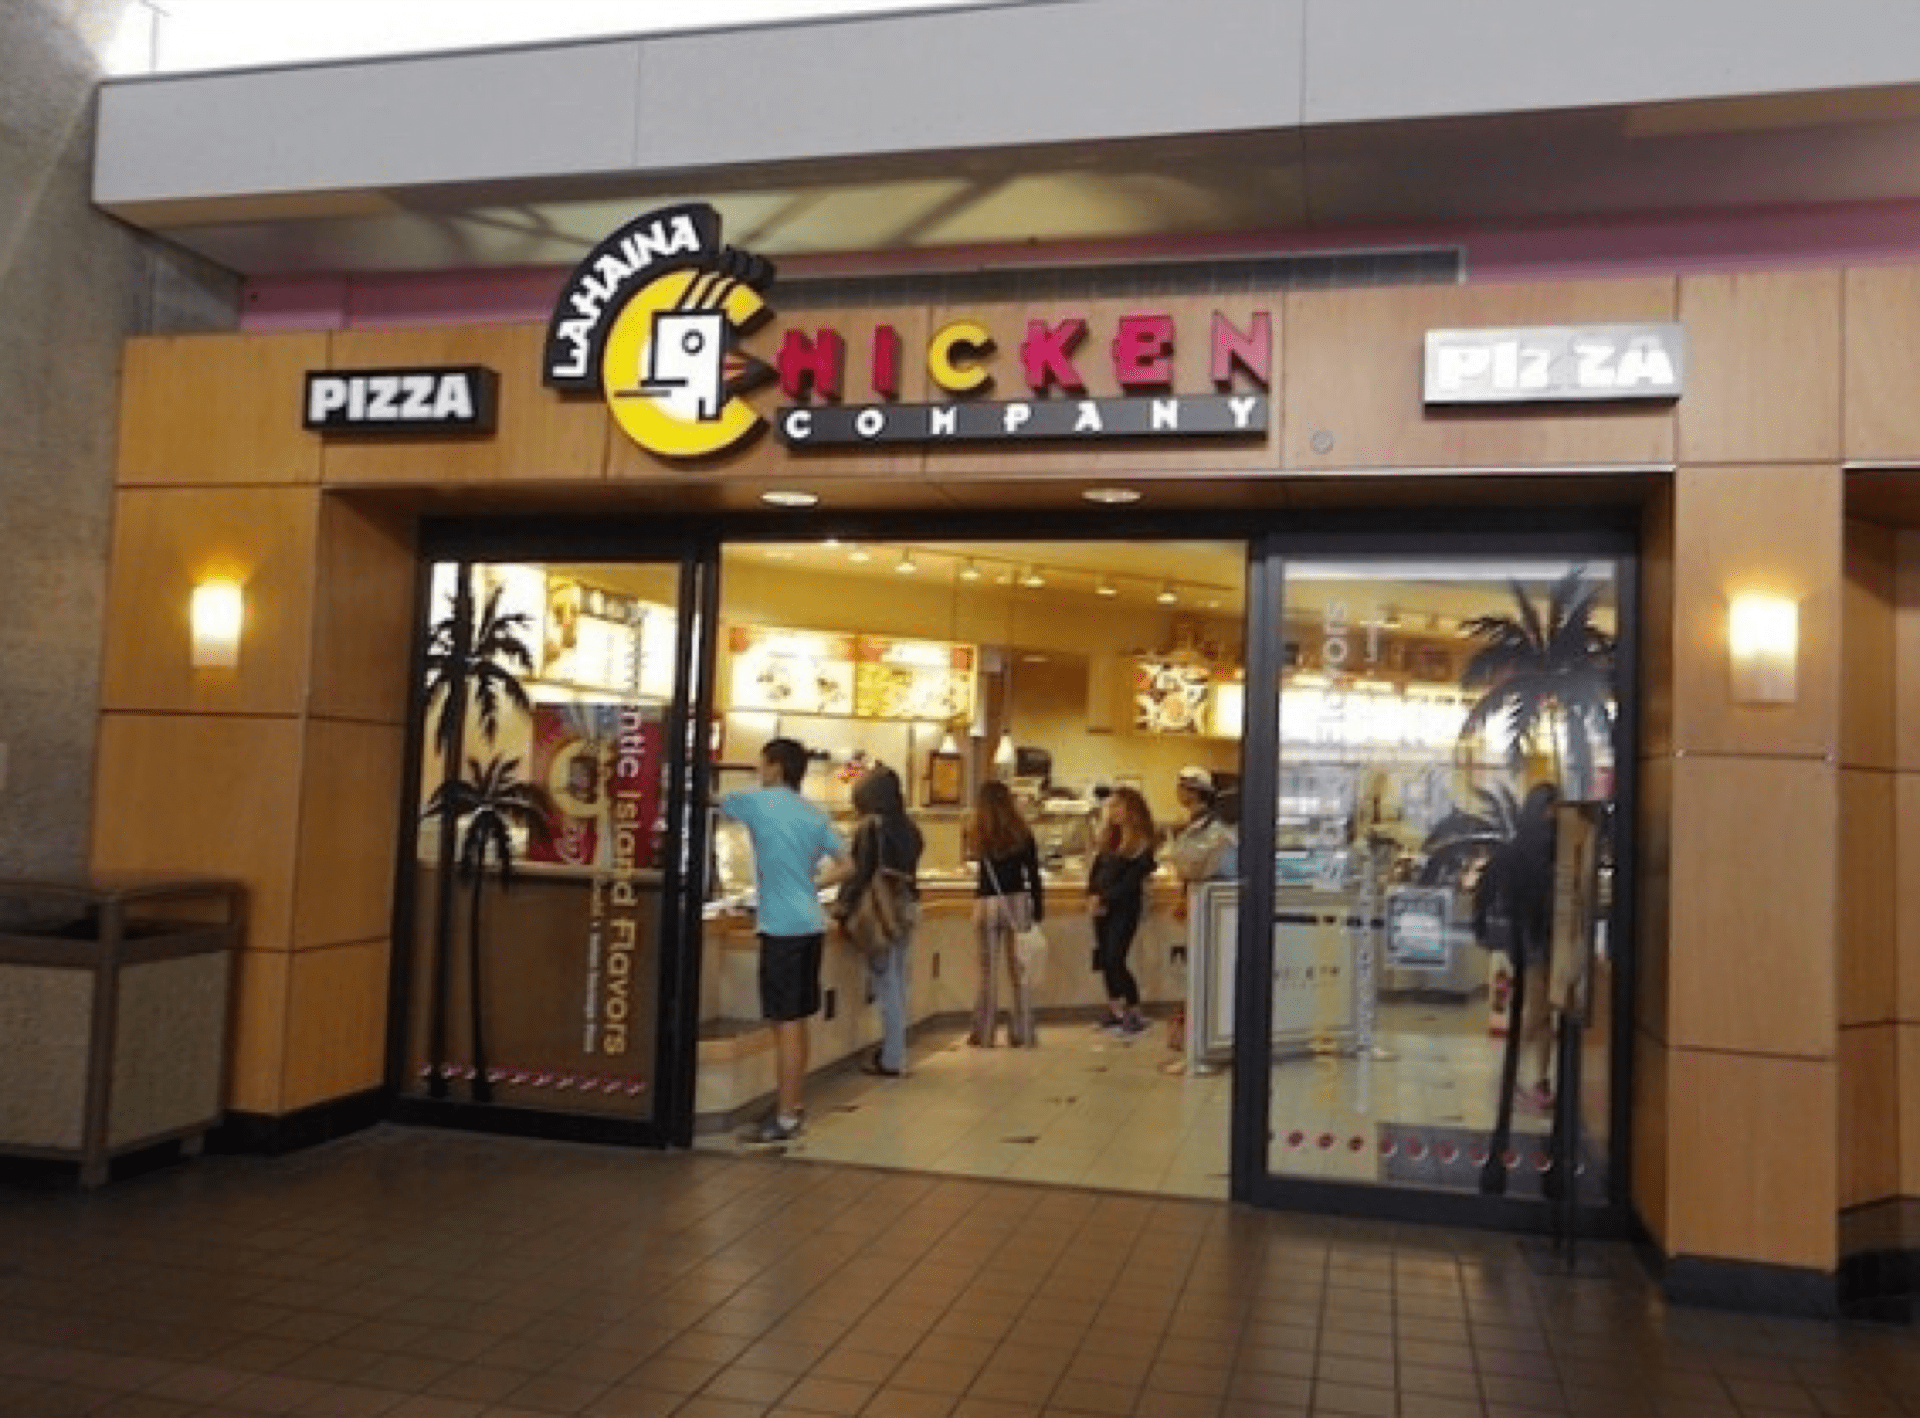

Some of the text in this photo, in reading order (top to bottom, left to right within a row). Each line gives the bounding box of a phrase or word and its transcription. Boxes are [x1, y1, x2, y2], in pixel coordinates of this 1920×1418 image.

[552, 215, 700, 377] LAHAINA
[1438, 335, 1675, 389] PIZZA
[307, 374, 474, 421] PIZZA
[785, 397, 1257, 439] COMPANY
[603, 918, 636, 1055] Flavors
